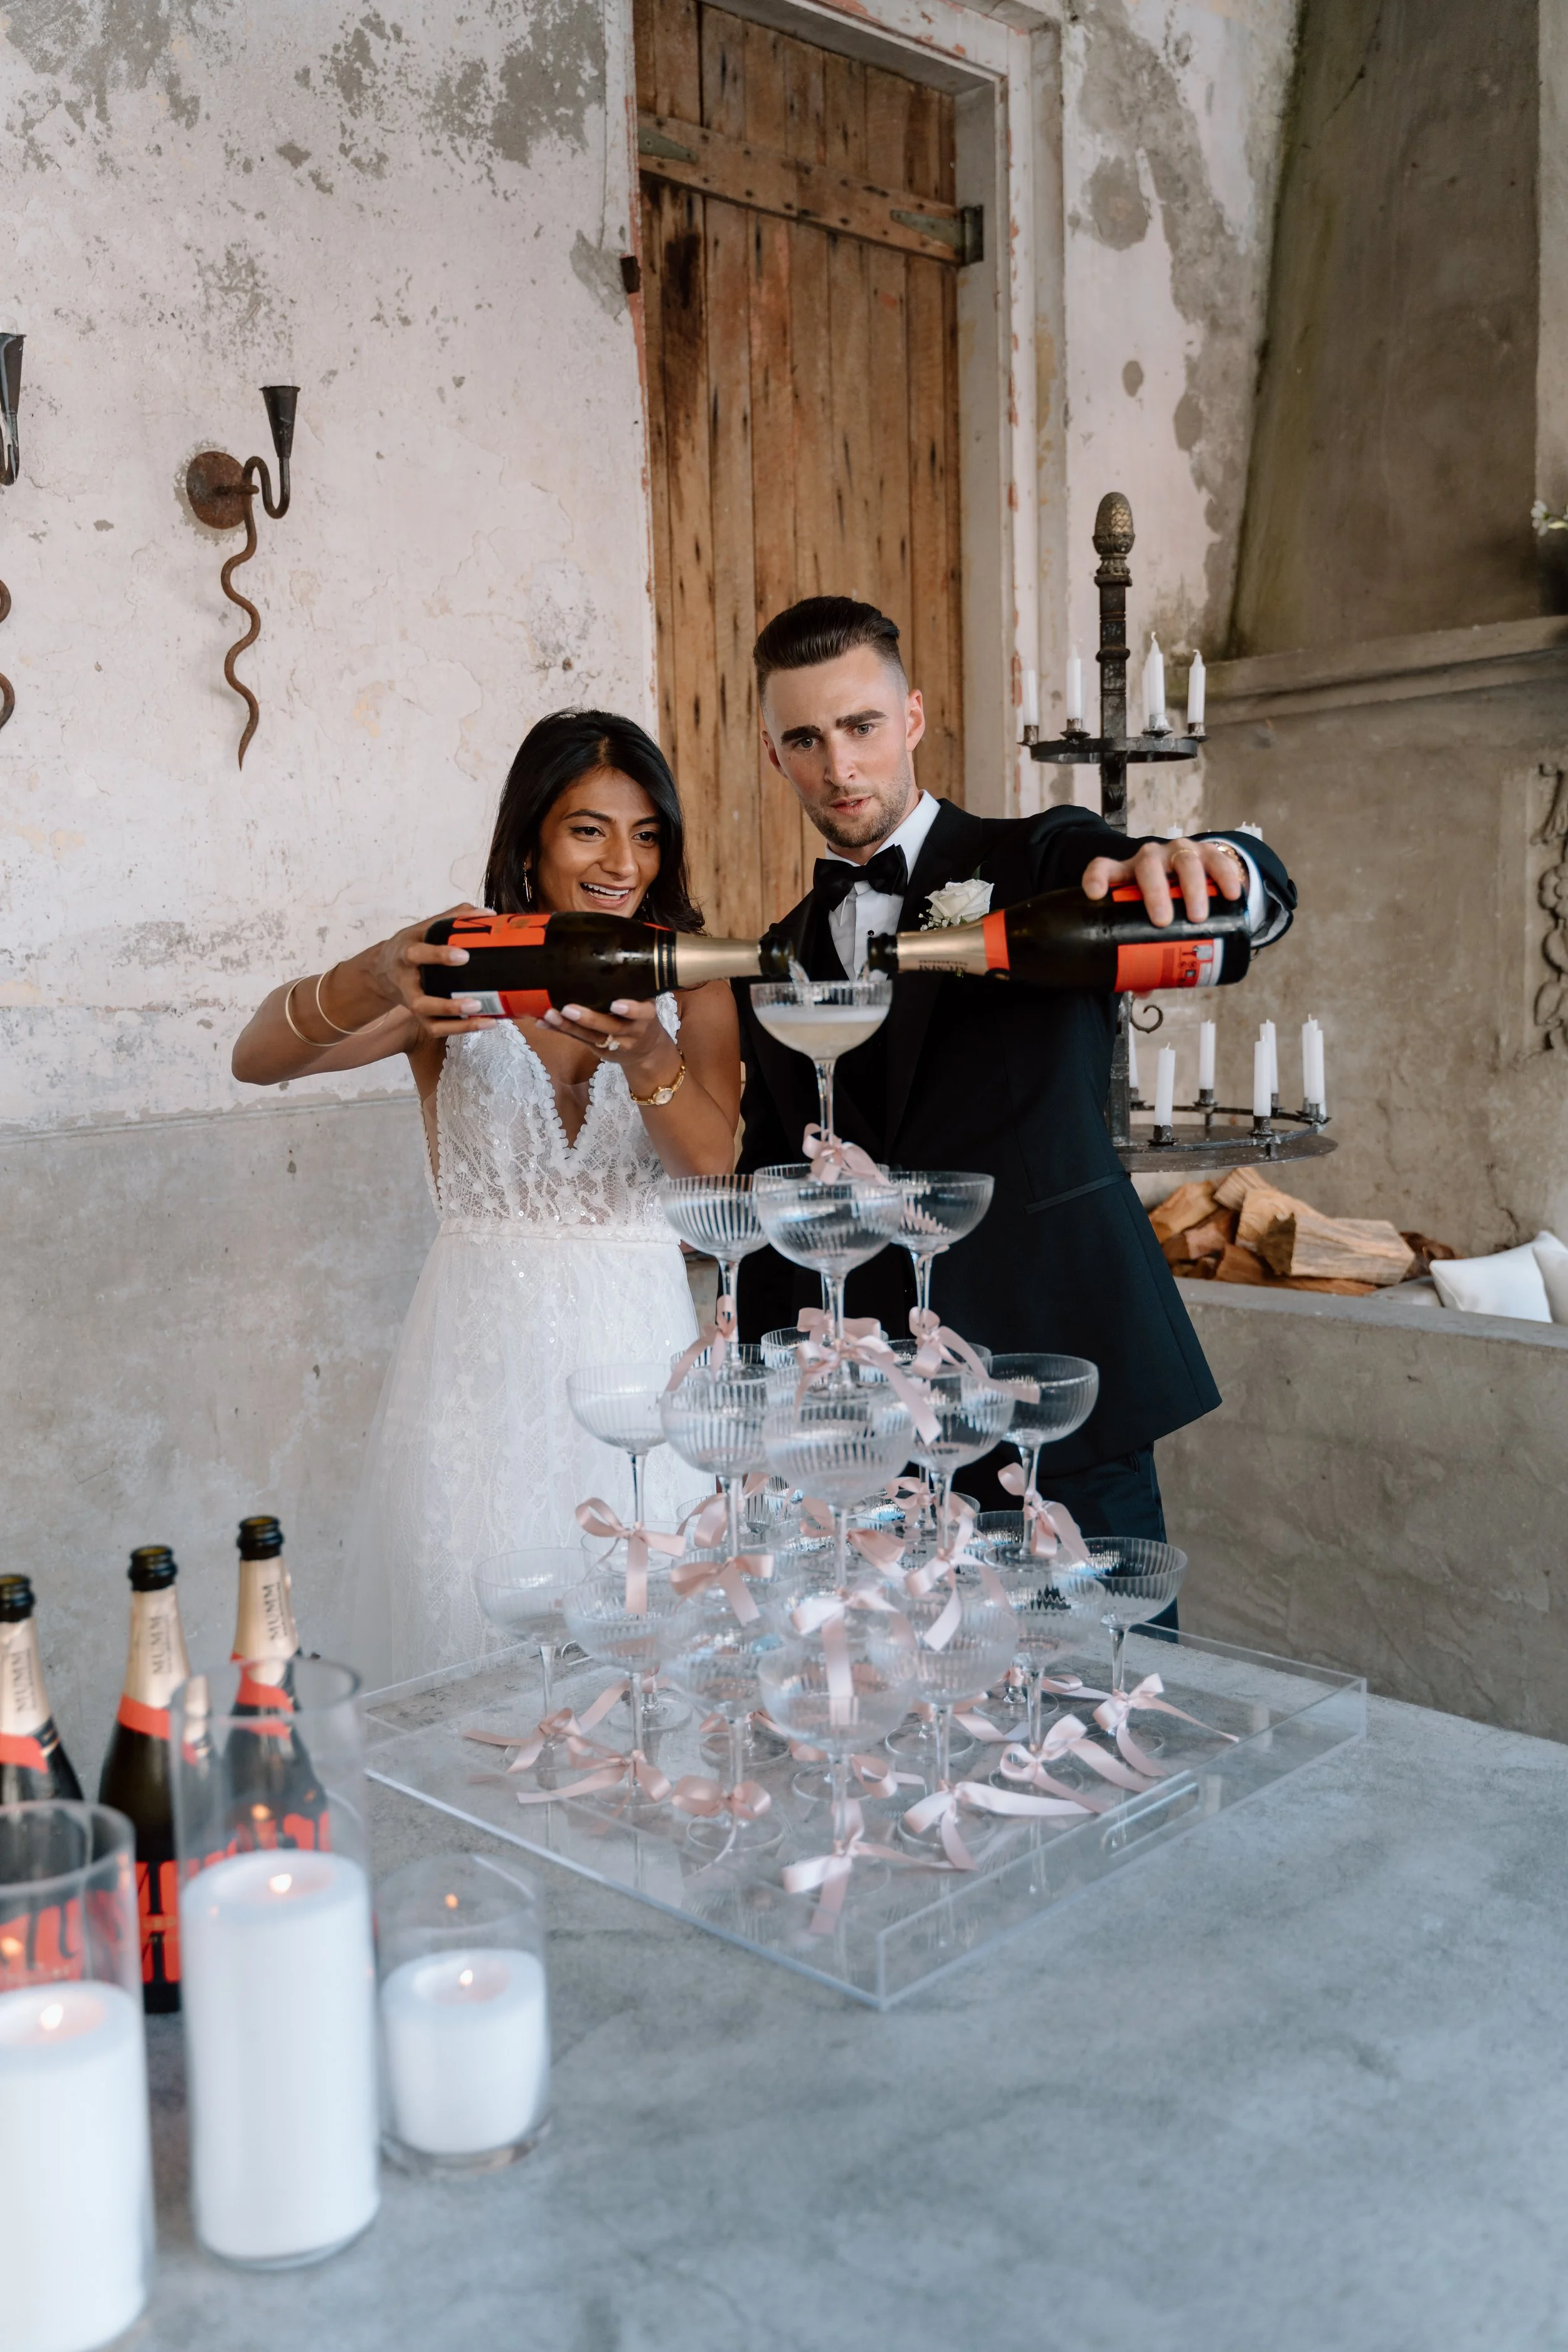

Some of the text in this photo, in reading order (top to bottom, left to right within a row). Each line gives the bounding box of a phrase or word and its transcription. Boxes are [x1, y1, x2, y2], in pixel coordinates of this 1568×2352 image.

[262, 1584, 280, 1641] MUMM
[149, 1616, 165, 1674] MUMM
[11, 1650, 31, 1712] MUMM
